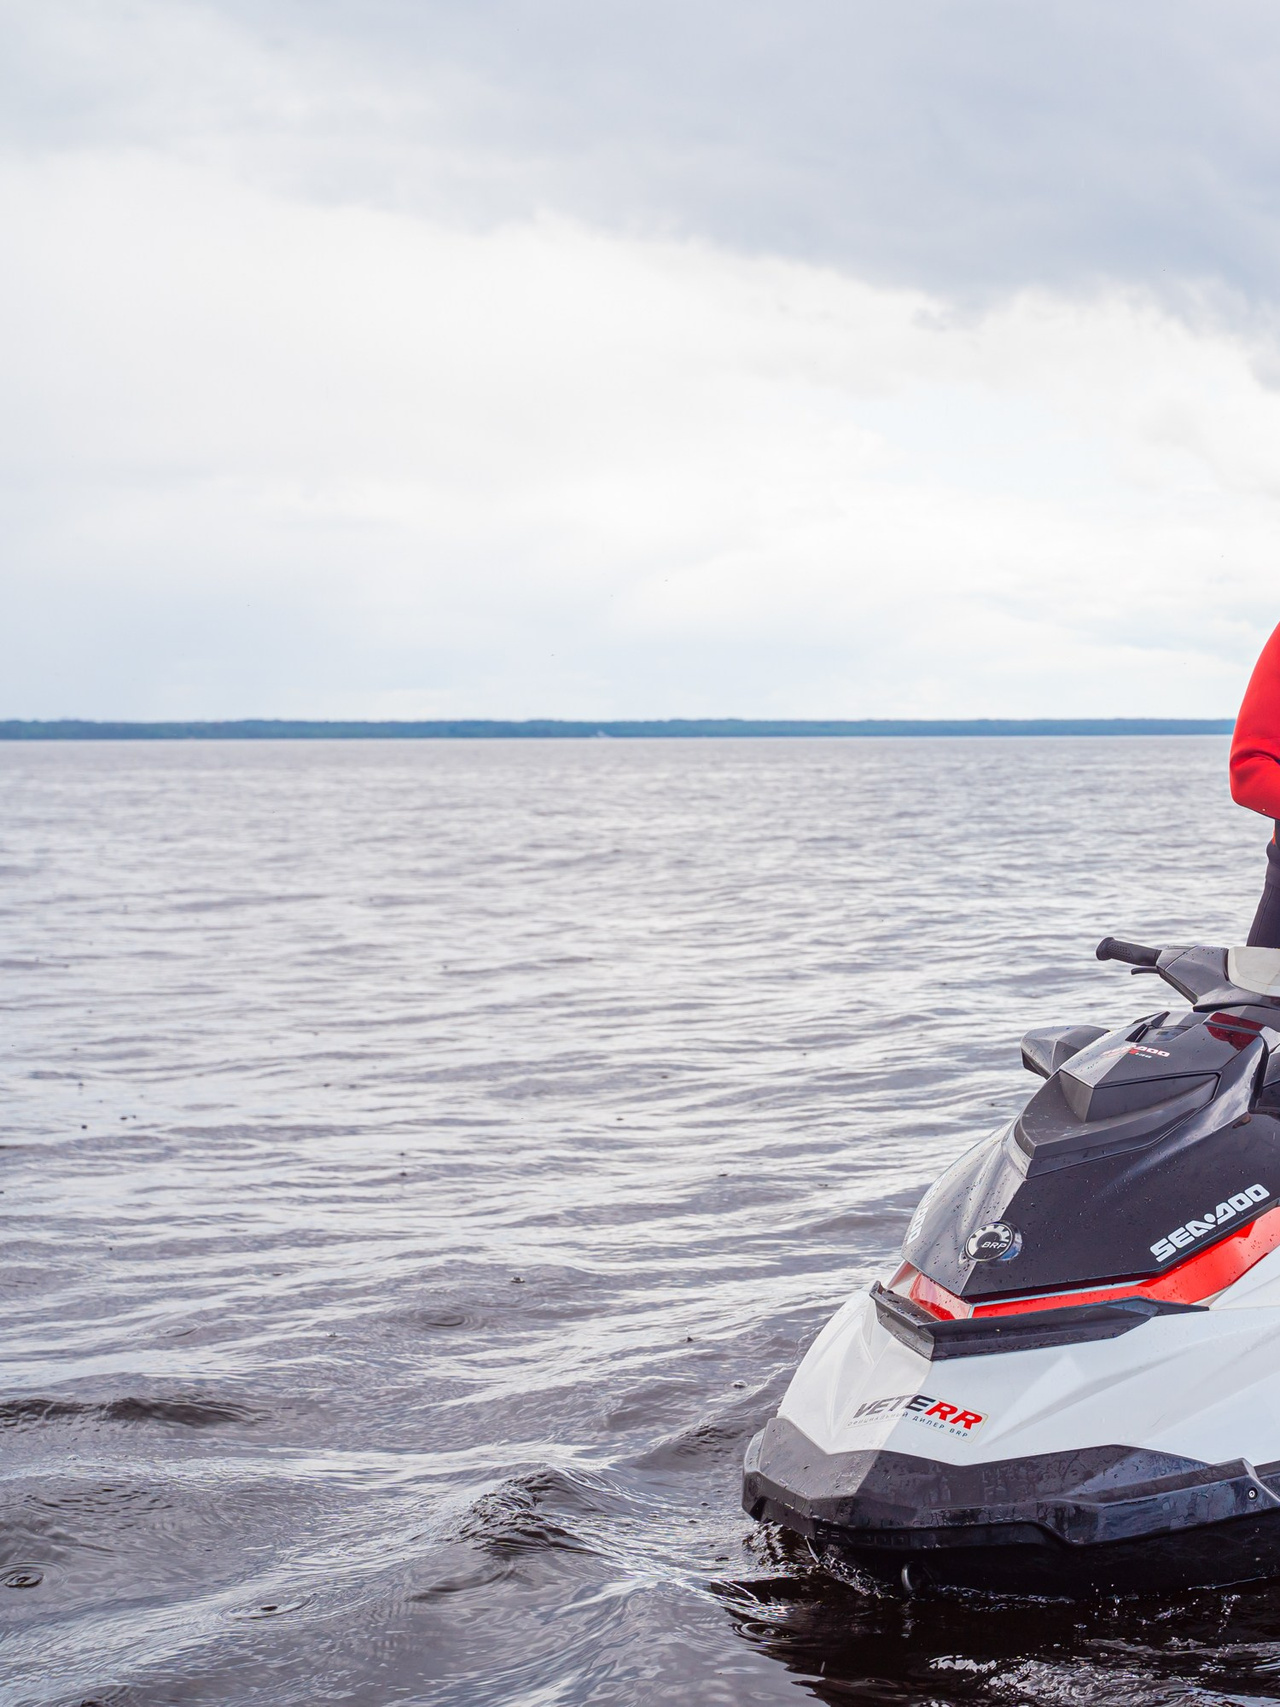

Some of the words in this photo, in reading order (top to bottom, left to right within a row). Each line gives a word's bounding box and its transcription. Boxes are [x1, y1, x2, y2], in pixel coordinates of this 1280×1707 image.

[981, 1241, 1007, 1249] BRP
[853, 1394, 983, 1430] VETERR
[912, 1415, 945, 1430] ДИЛЕР
